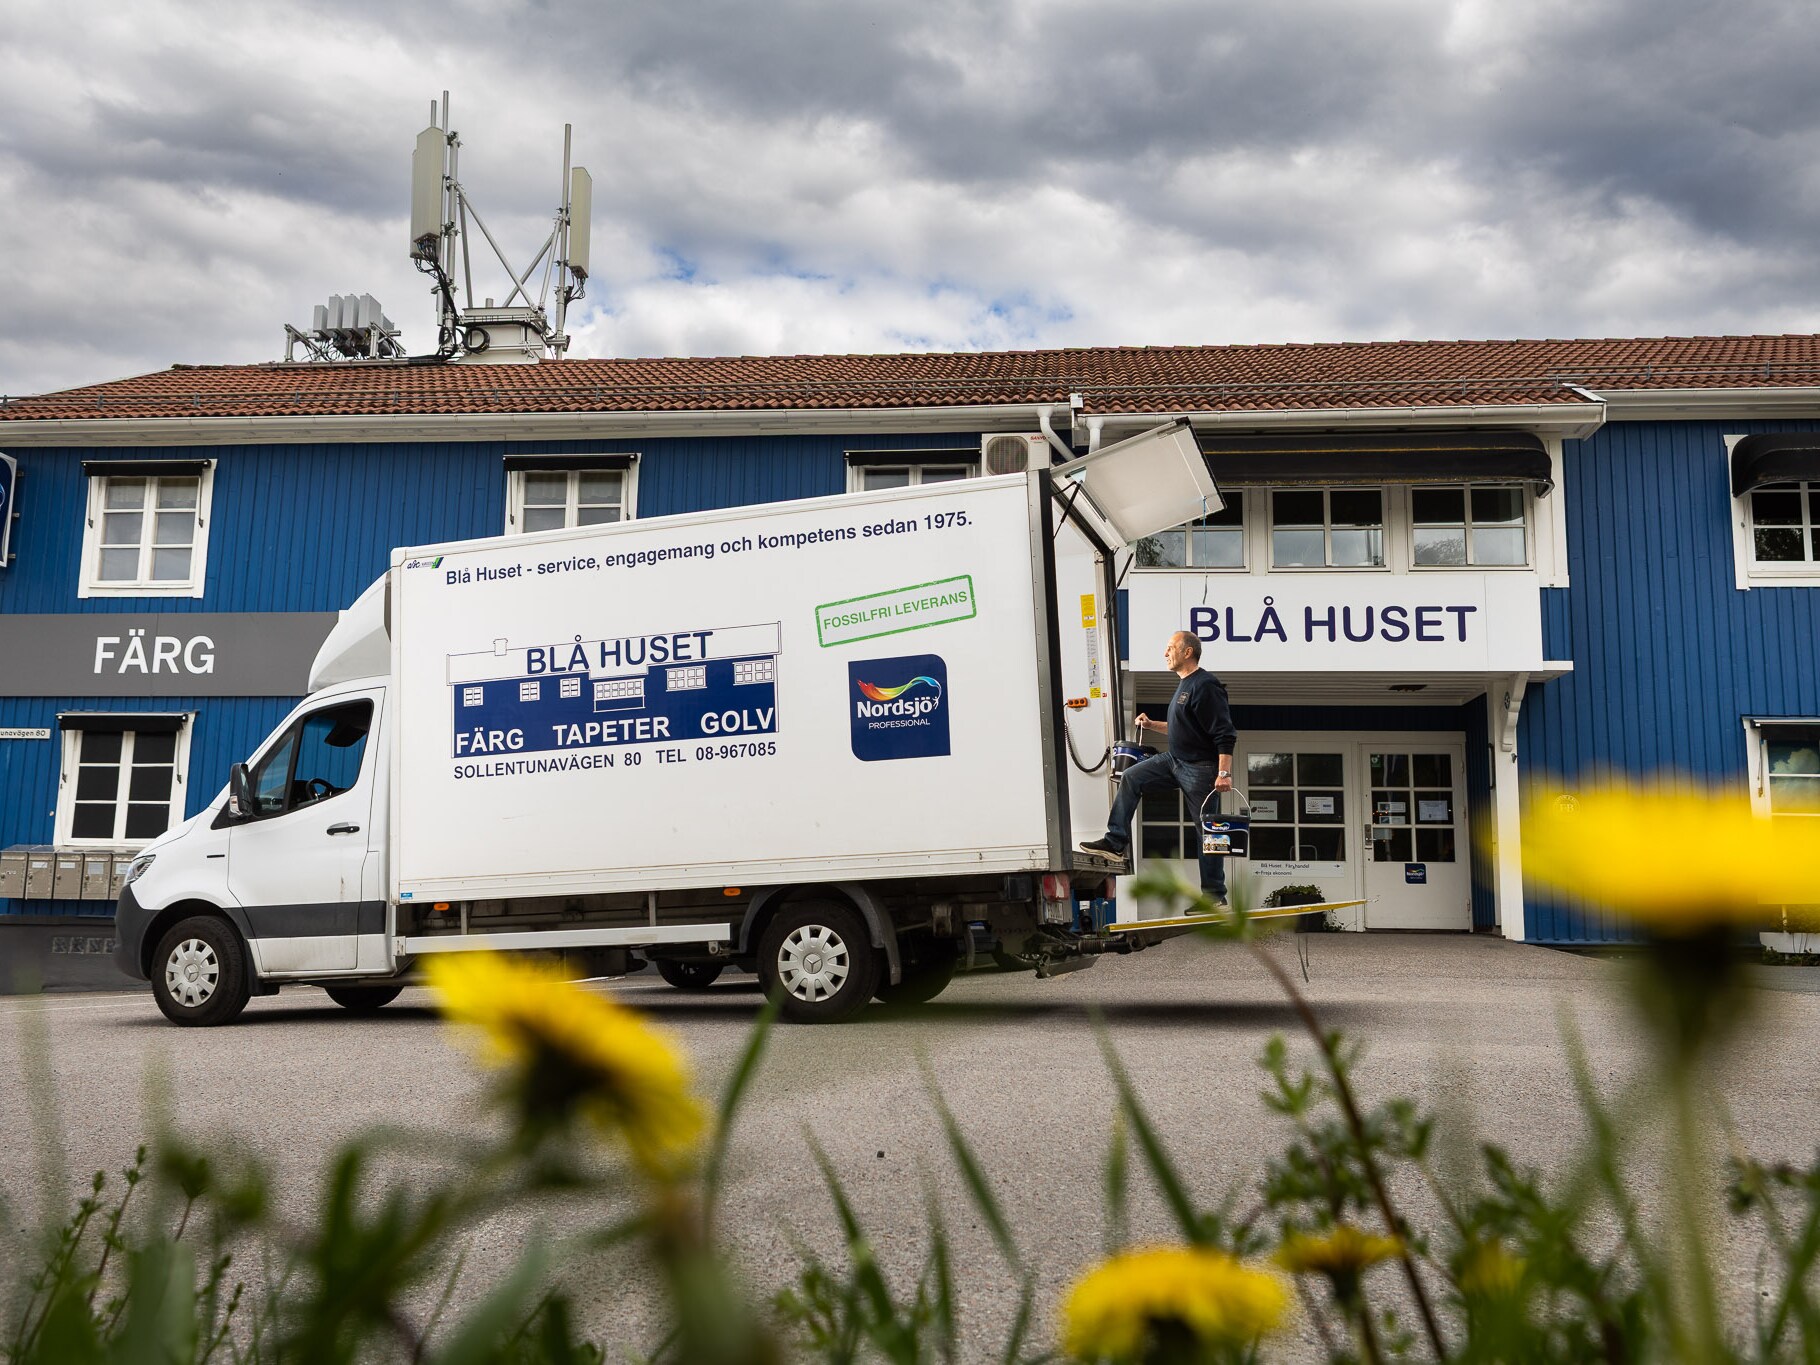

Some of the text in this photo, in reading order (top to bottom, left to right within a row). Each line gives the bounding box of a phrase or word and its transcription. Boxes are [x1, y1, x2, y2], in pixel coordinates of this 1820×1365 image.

[446, 568, 471, 585] Blå
[476, 563, 522, 581] Huset
[537, 555, 600, 575] service,
[605, 543, 715, 567] engagemang
[720, 536, 752, 553] och
[758, 526, 856, 549] kompetens
[862, 517, 917, 537] sedan
[924, 510, 973, 530] 1975.
[823, 591, 968, 630] FOSSILFRI LEVERANS
[1190, 596, 1477, 642] BLÅ HUSET
[94, 628, 215, 674] FÄRG
[527, 631, 713, 675] BLÅ HUSET
[857, 696, 933, 718] Nordsjö
[868, 718, 931, 730] PROFESSIONAL
[456, 707, 774, 754] FÄRG TAPETER GOLV
[454, 741, 777, 779] SOLLENTUNAVÄGEN 80 TEL 08-967085
